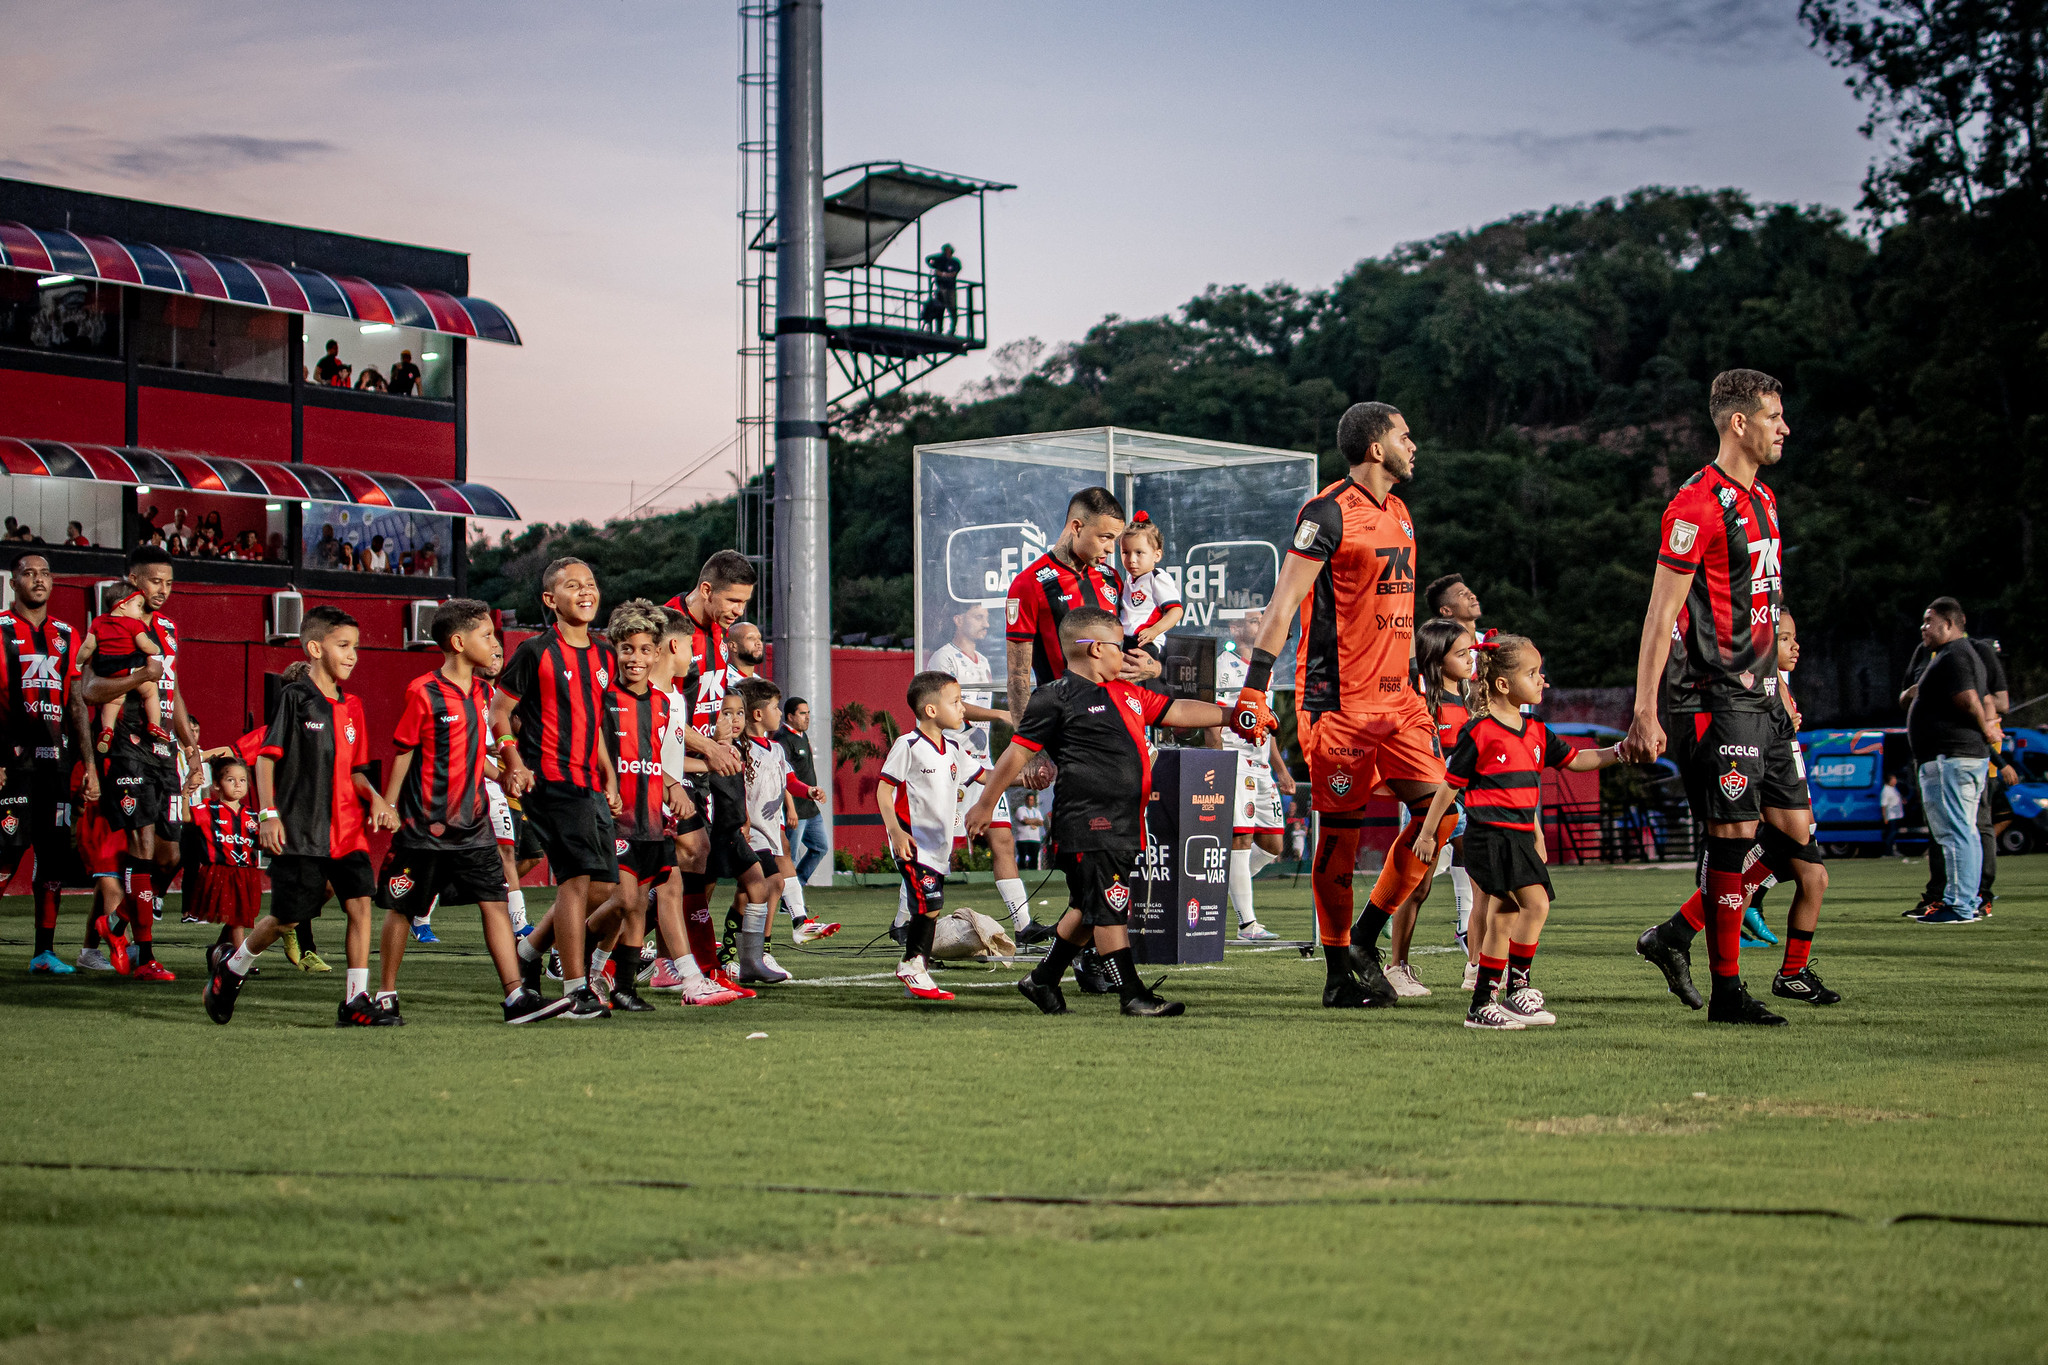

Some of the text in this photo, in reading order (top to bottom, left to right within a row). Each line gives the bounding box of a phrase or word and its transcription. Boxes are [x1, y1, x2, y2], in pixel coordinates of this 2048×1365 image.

[1375, 547, 1414, 581] 7K
[19, 654, 62, 680] 7K
[1180, 666, 1198, 681] FBF
[1182, 682, 1198, 693] VAR
[1379, 682, 1402, 693] PISOS
[1088, 705, 1106, 714] VOLT
[305, 721, 324, 729] VOLT
[441, 715, 459, 723] VOLT
[35, 751, 60, 759] PISOS
[1328, 747, 1365, 758] acelen
[1719, 744, 1760, 758] acelen
[1810, 763, 1856, 777] ALMED
[1192, 793, 1225, 805] BAIANÃO
[503, 816, 511, 831] 5
[1203, 847, 1228, 869] FBF
[1140, 866, 1171, 881] VAR
[1206, 869, 1226, 884] VAR
